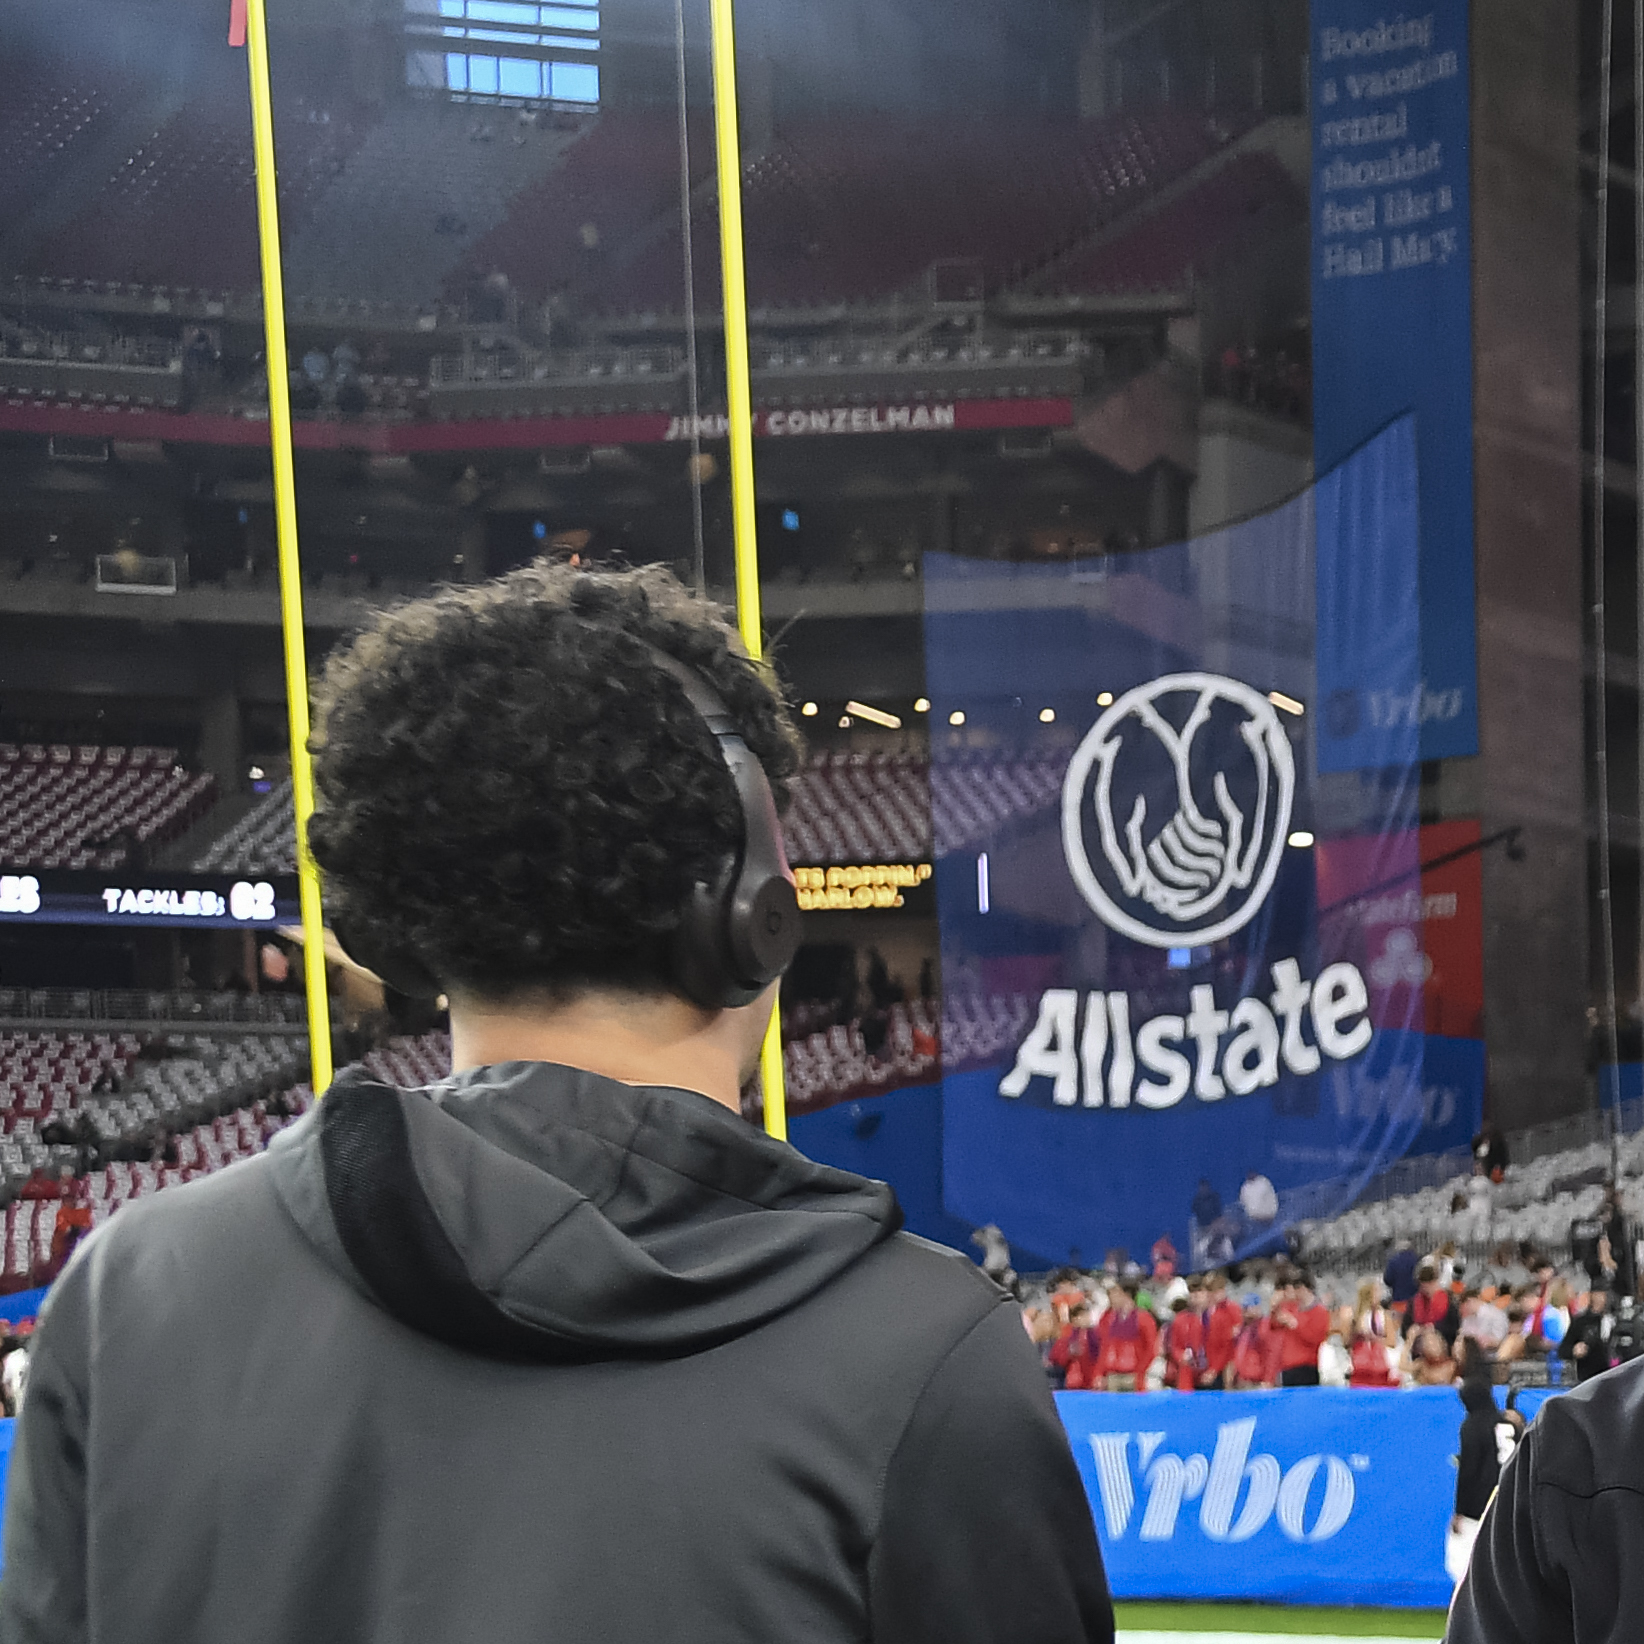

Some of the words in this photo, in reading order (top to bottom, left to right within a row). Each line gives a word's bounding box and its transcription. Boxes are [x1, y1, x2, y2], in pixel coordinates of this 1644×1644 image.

[766, 404, 956, 436] CONZELMAN
[102, 888, 226, 916] TACKLES:
[998, 957, 1374, 1110] Allstate
[1089, 1415, 1356, 1543] Vrbo
